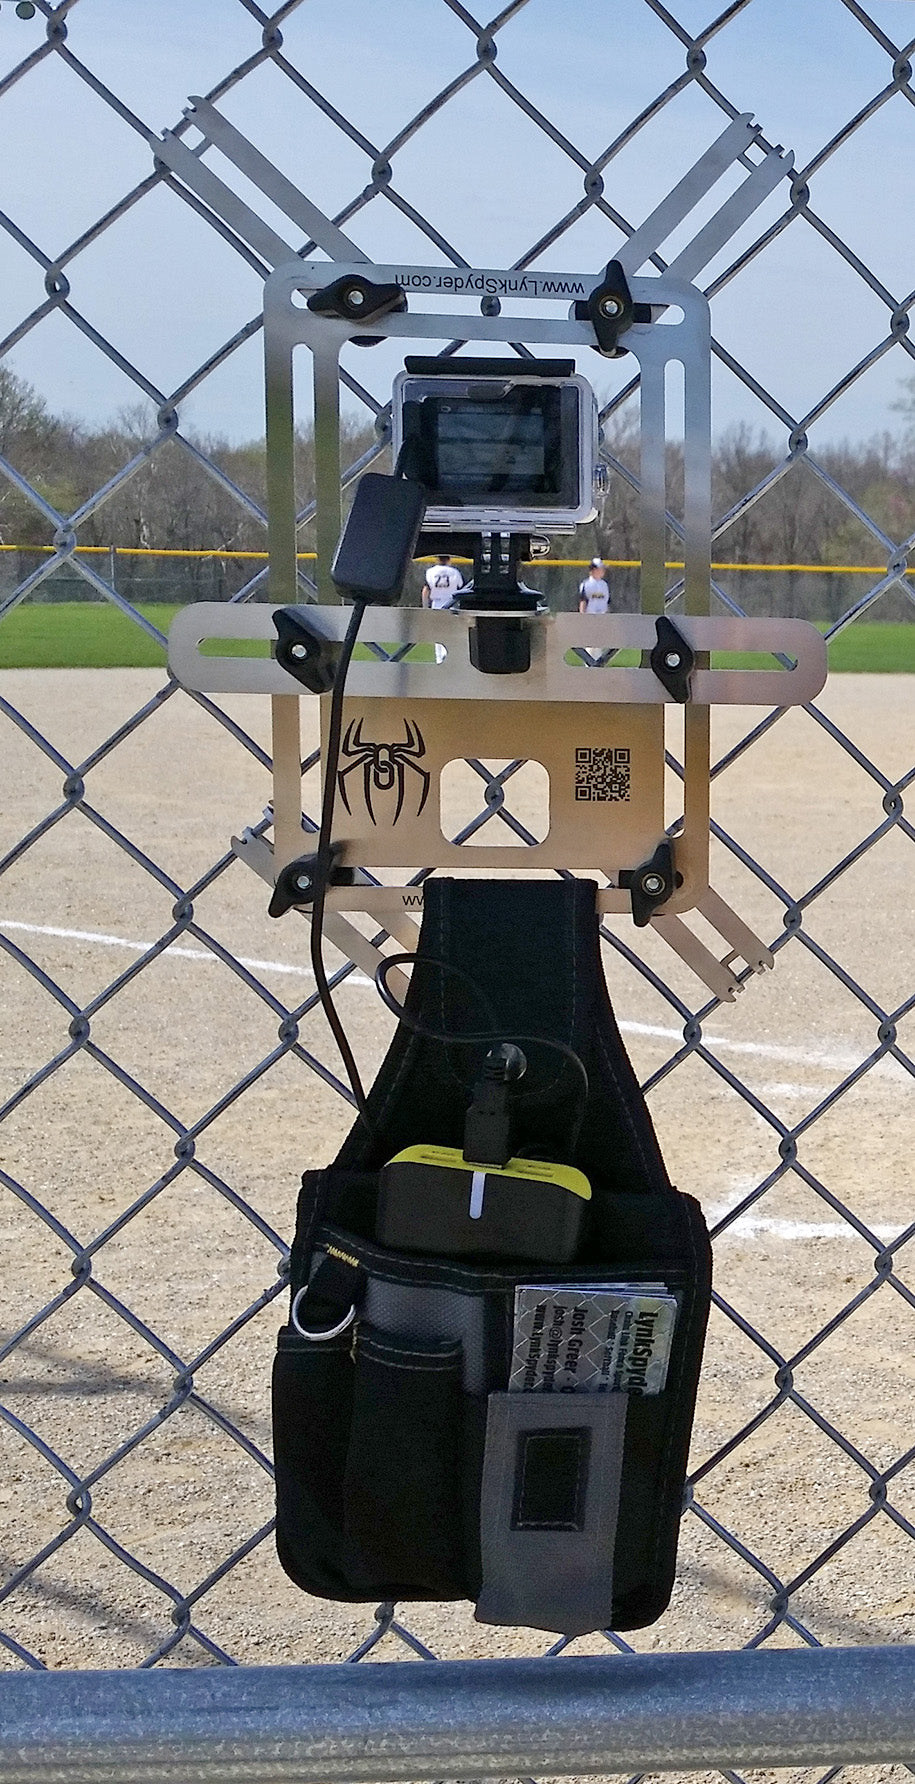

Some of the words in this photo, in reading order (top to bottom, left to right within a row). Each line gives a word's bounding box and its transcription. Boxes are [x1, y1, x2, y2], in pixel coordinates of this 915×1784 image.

[395, 274, 585, 295] www.LynkSpyder.com
[434, 575, 450, 588] 23
[569, 1306, 589, 1335] Josh
[563, 1339, 584, 1374] Greer
